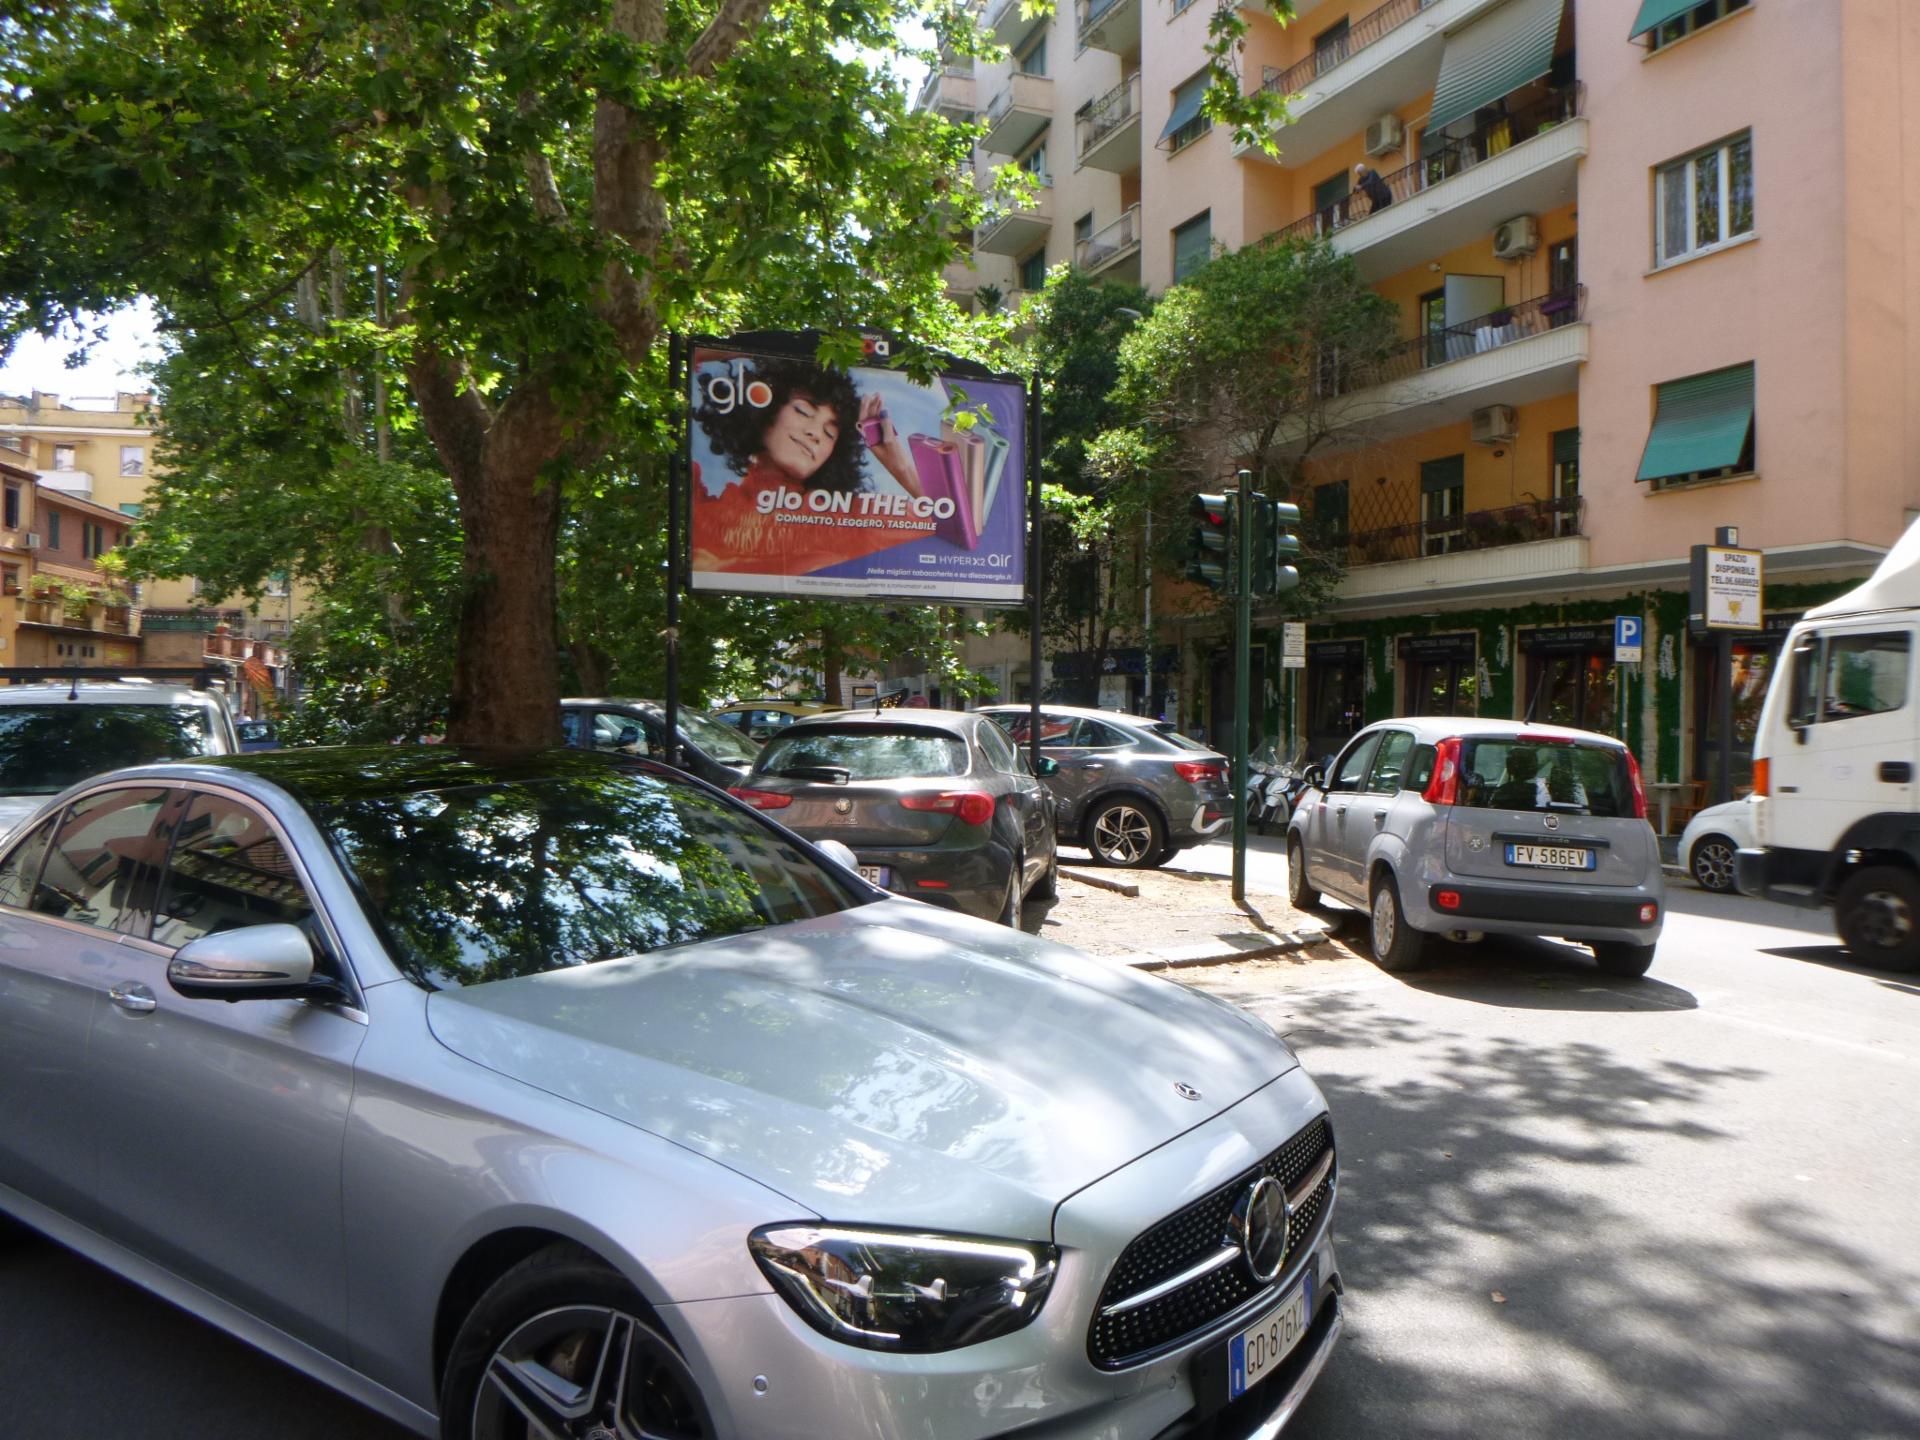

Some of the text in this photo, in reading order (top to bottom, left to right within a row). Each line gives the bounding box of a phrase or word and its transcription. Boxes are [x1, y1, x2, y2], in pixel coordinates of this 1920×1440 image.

[708, 362, 772, 414] glo
[756, 486, 955, 519] glo ON THE GO
[776, 514, 937, 531] COMPATTO, LEGGERO, TASCABILE
[1724, 553, 1748, 563] SPAZIO
[1715, 564, 1756, 575] DISPONIBILE
[1620, 620, 1637, 644] P
[1516, 846, 1534, 863] FV
[1540, 848, 1585, 866] 586EV
[1247, 1333, 1265, 1375] GD
[1271, 1294, 1303, 1357] 876XZ
